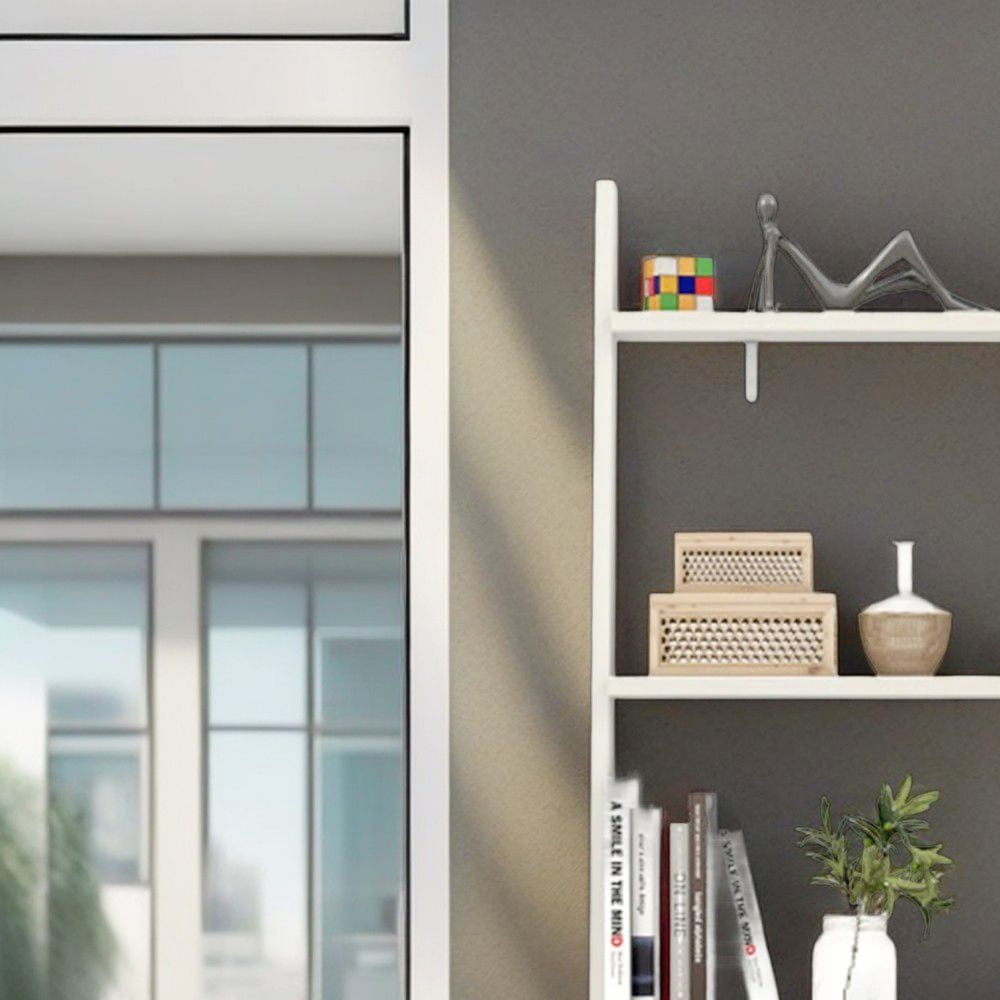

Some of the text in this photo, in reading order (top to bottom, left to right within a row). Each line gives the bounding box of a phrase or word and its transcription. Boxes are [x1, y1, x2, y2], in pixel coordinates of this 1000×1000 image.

[611, 802, 622, 811] A
[611, 815, 623, 857] SMILE
[611, 861, 623, 876] IN
[611, 880, 623, 905] THE
[611, 909, 623, 947] MIND
